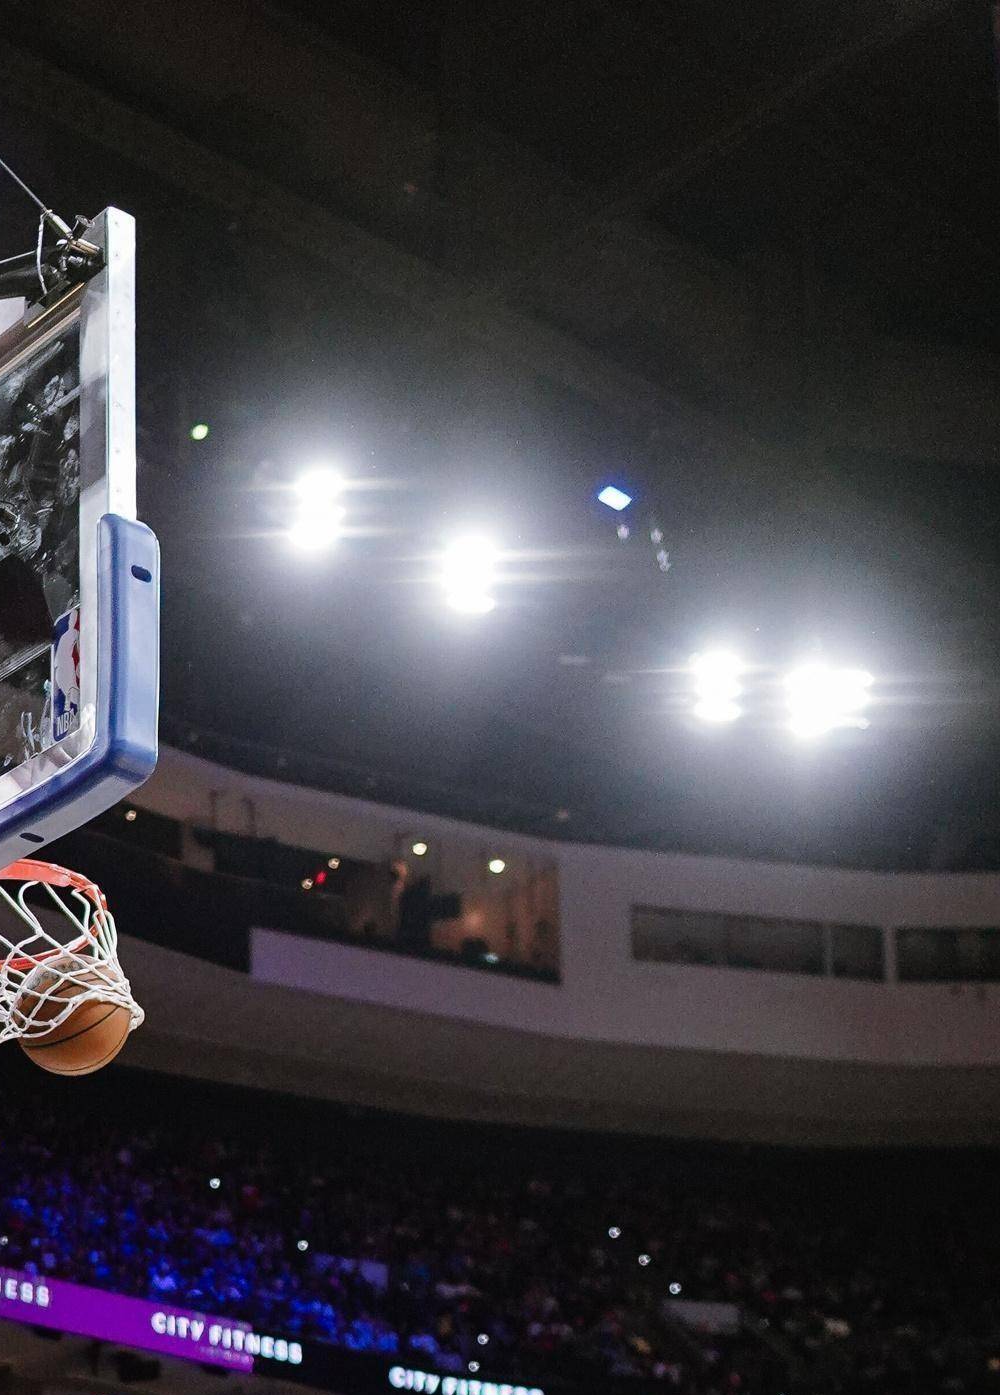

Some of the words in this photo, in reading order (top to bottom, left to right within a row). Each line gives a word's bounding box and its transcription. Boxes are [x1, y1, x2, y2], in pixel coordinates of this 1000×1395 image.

[151, 1311, 204, 1342] CITY
[208, 1325, 303, 1365] FITNESS
[388, 1366, 440, 1395] CITY
